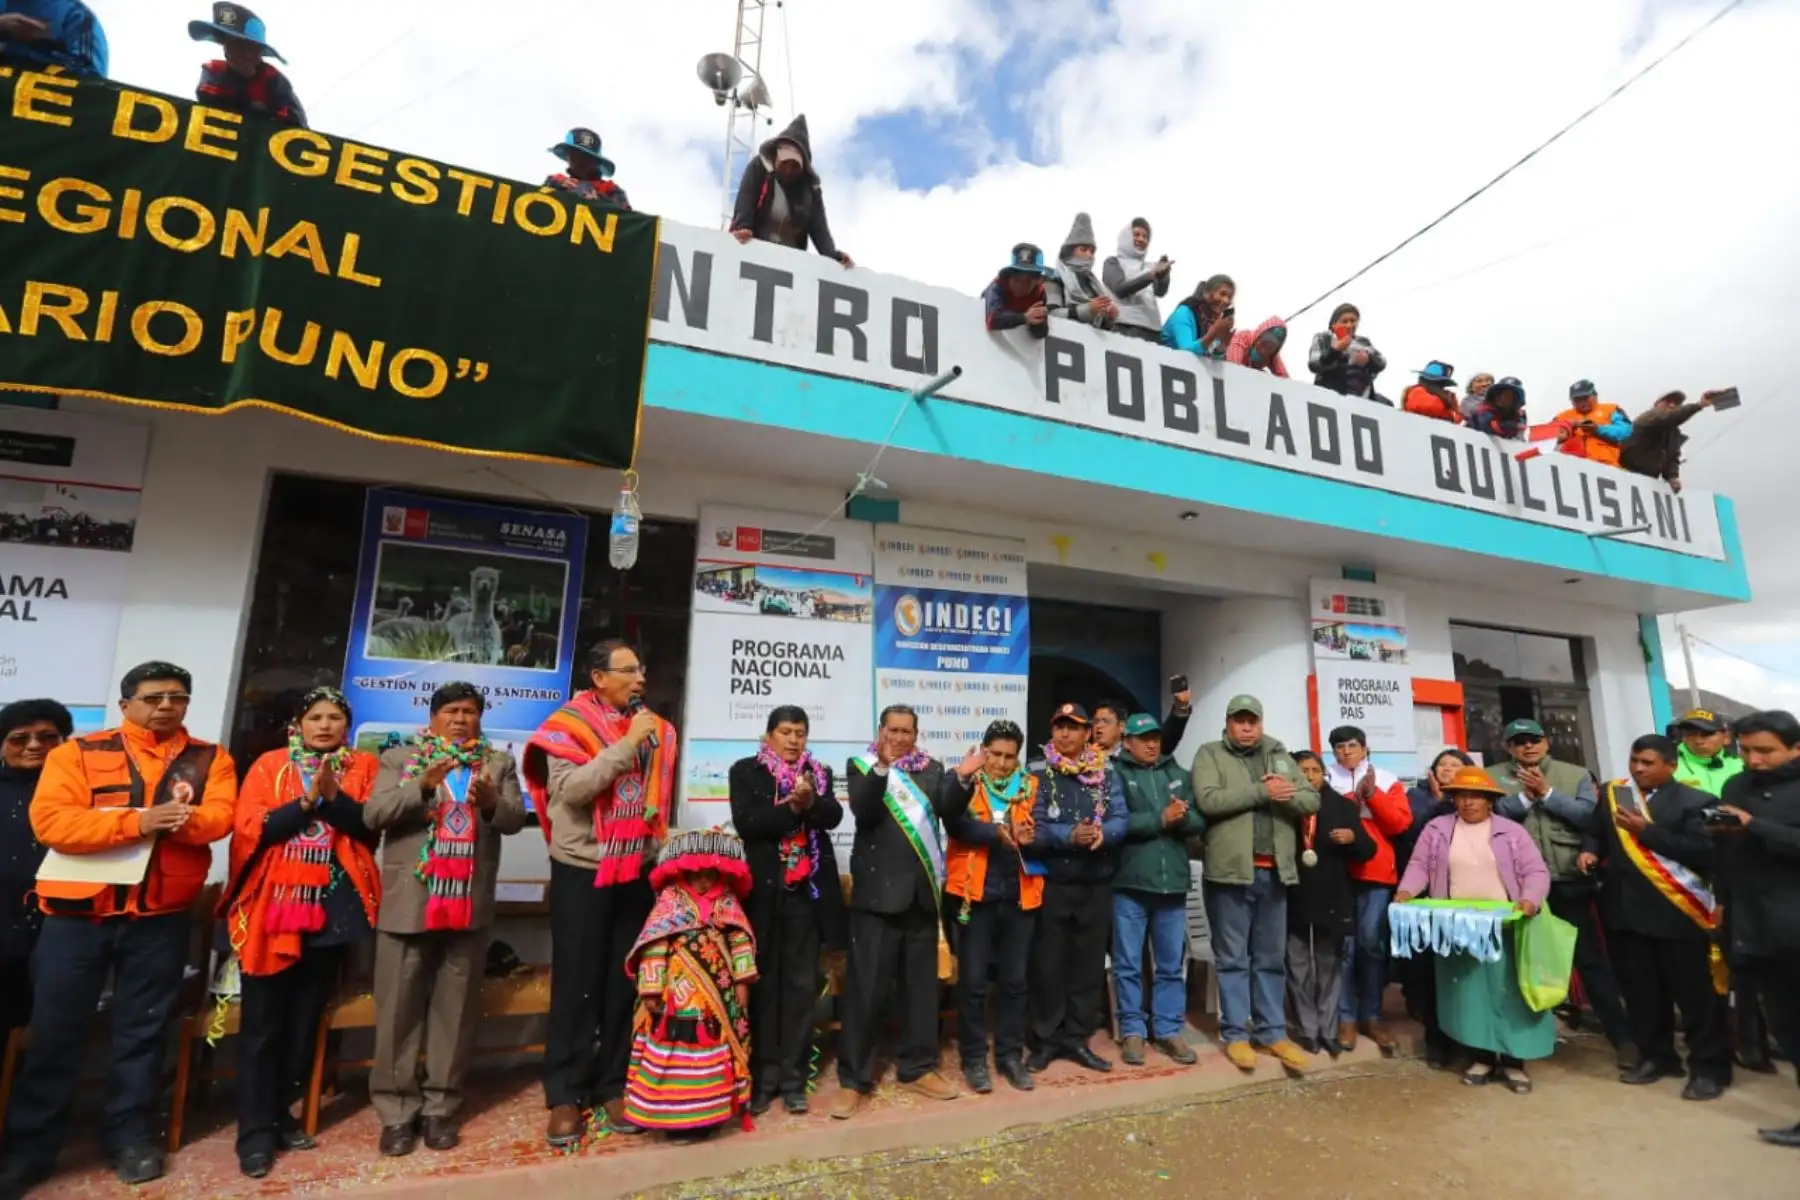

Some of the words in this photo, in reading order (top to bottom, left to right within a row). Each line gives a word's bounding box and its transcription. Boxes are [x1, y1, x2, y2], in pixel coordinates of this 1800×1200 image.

[111, 91, 243, 162] DE
[268, 127, 618, 254] GESTIÓN
[1044, 335, 1384, 476] POBLADO
[1431, 434, 1693, 544] QUILLISANI
[499, 522, 567, 541] SENASA
[924, 601, 1012, 631] INDECI
[731, 638, 845, 662] PROGRAMA
[730, 658, 832, 680] NACIONAL
[937, 656, 970, 669] PUNO
[494, 687, 562, 700] SANITARIO
[730, 679, 773, 696] PAIS
[1337, 678, 1400, 692] PROGRAMA
[1339, 692, 1393, 707] NACIONAL
[1340, 706, 1365, 720] PAIS
